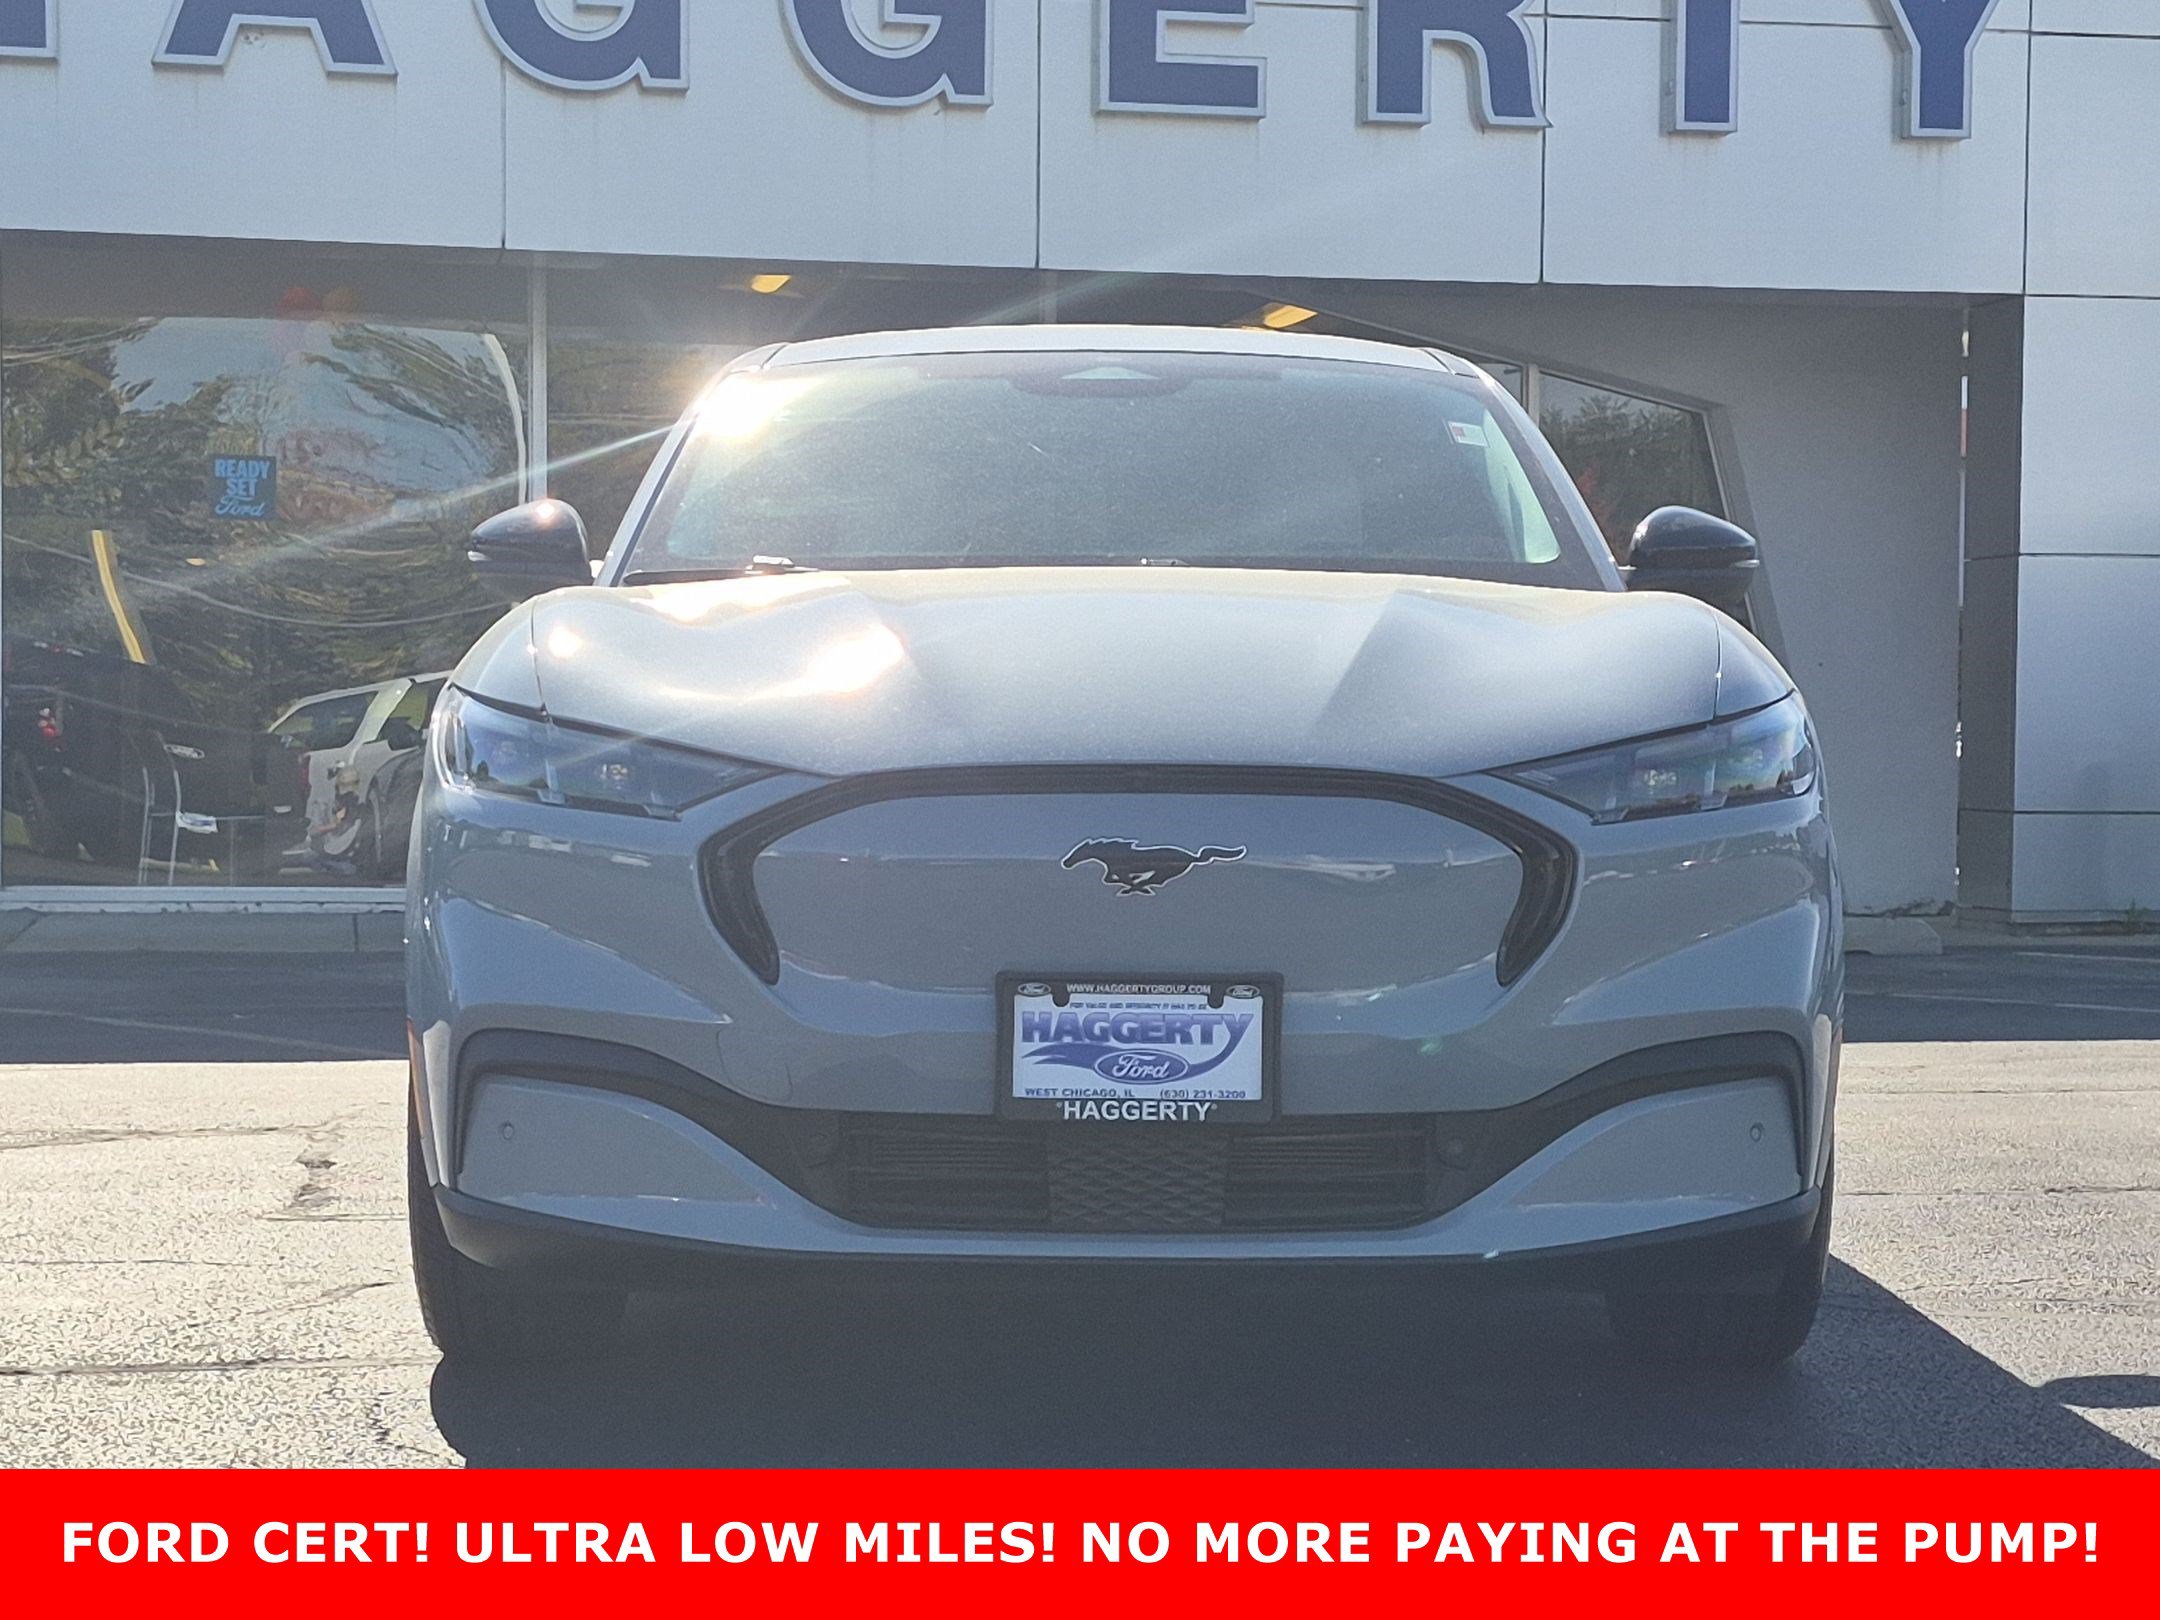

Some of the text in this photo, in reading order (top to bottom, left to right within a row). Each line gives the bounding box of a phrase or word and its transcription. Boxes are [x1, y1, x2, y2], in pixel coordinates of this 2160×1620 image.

[215, 459, 270, 479] READY
[226, 479, 258, 497] SET
[215, 495, 265, 517] Ford
[1066, 983, 1212, 995] WWW.HAGGERTYGROUP.COM
[1021, 1011, 1254, 1045] HAGGERTY
[1112, 1054, 1169, 1079] Ford
[1024, 1087, 1059, 1097] WEST
[1061, 1088, 1121, 1098] CHICAGO,
[1123, 1089, 1136, 1098] IL
[1063, 1100, 1212, 1122] HAGGERTY
